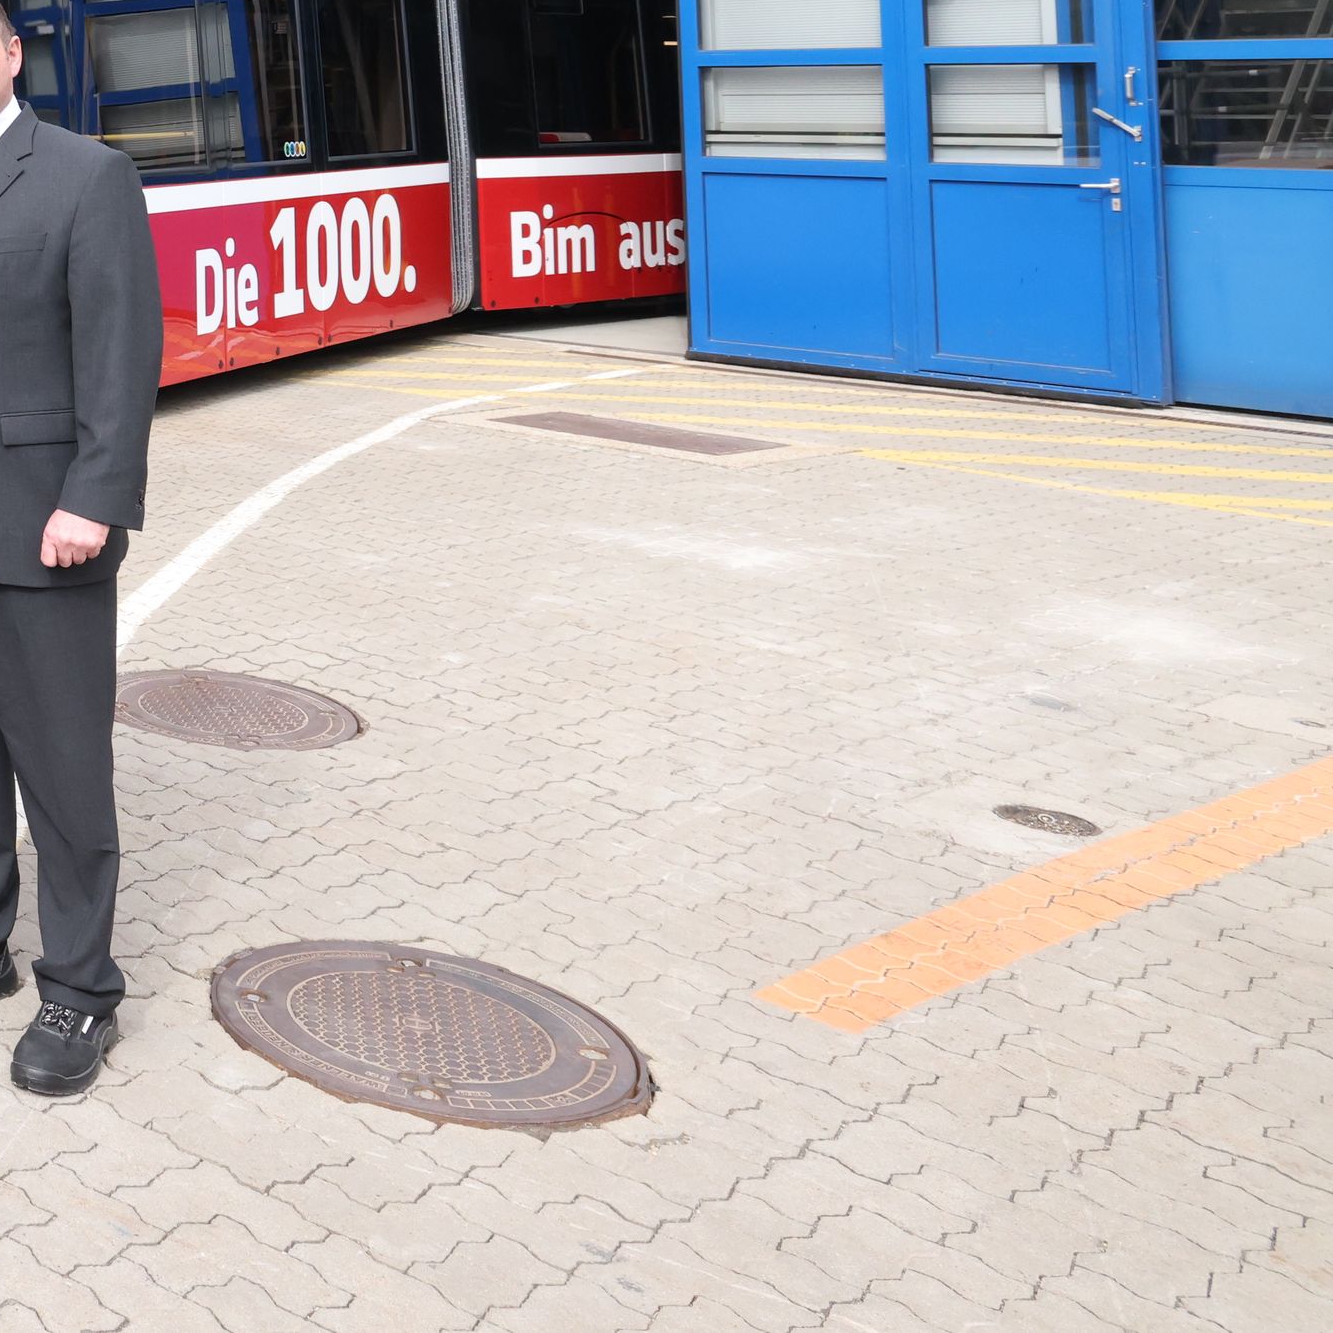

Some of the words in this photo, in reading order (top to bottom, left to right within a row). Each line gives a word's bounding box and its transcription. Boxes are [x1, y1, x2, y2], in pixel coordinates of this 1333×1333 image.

[194, 237, 260, 337] Die
[269, 193, 417, 320] 1000.
[509, 203, 597, 279] Bim
[618, 218, 686, 271] aus
